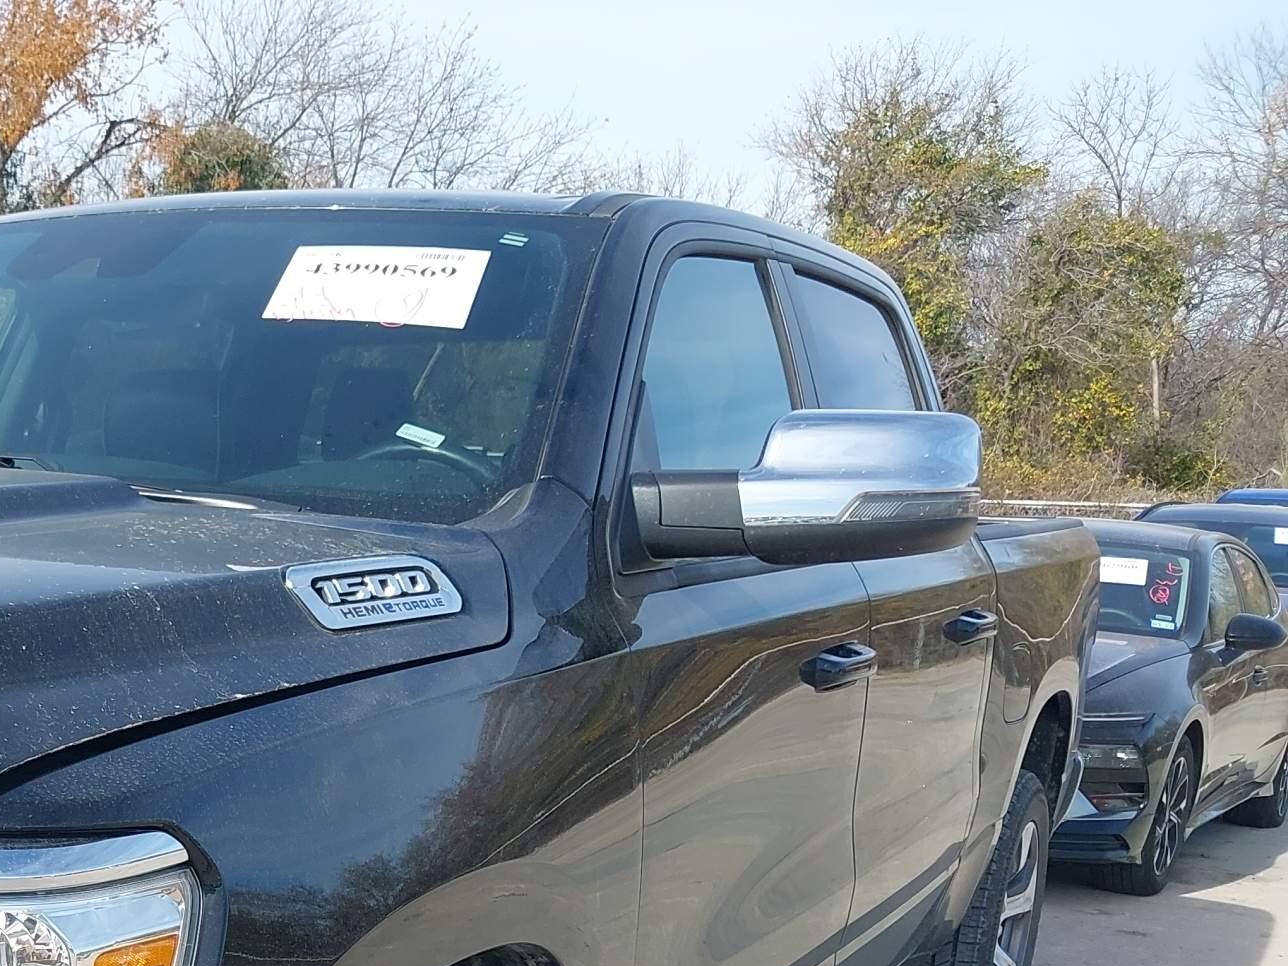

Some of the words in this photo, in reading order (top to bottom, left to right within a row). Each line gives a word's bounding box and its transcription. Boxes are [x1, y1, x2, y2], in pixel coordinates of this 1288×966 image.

[305, 261, 458, 279] 43990569
[315, 570, 431, 604] 1500
[340, 602, 385, 620] HEMI
